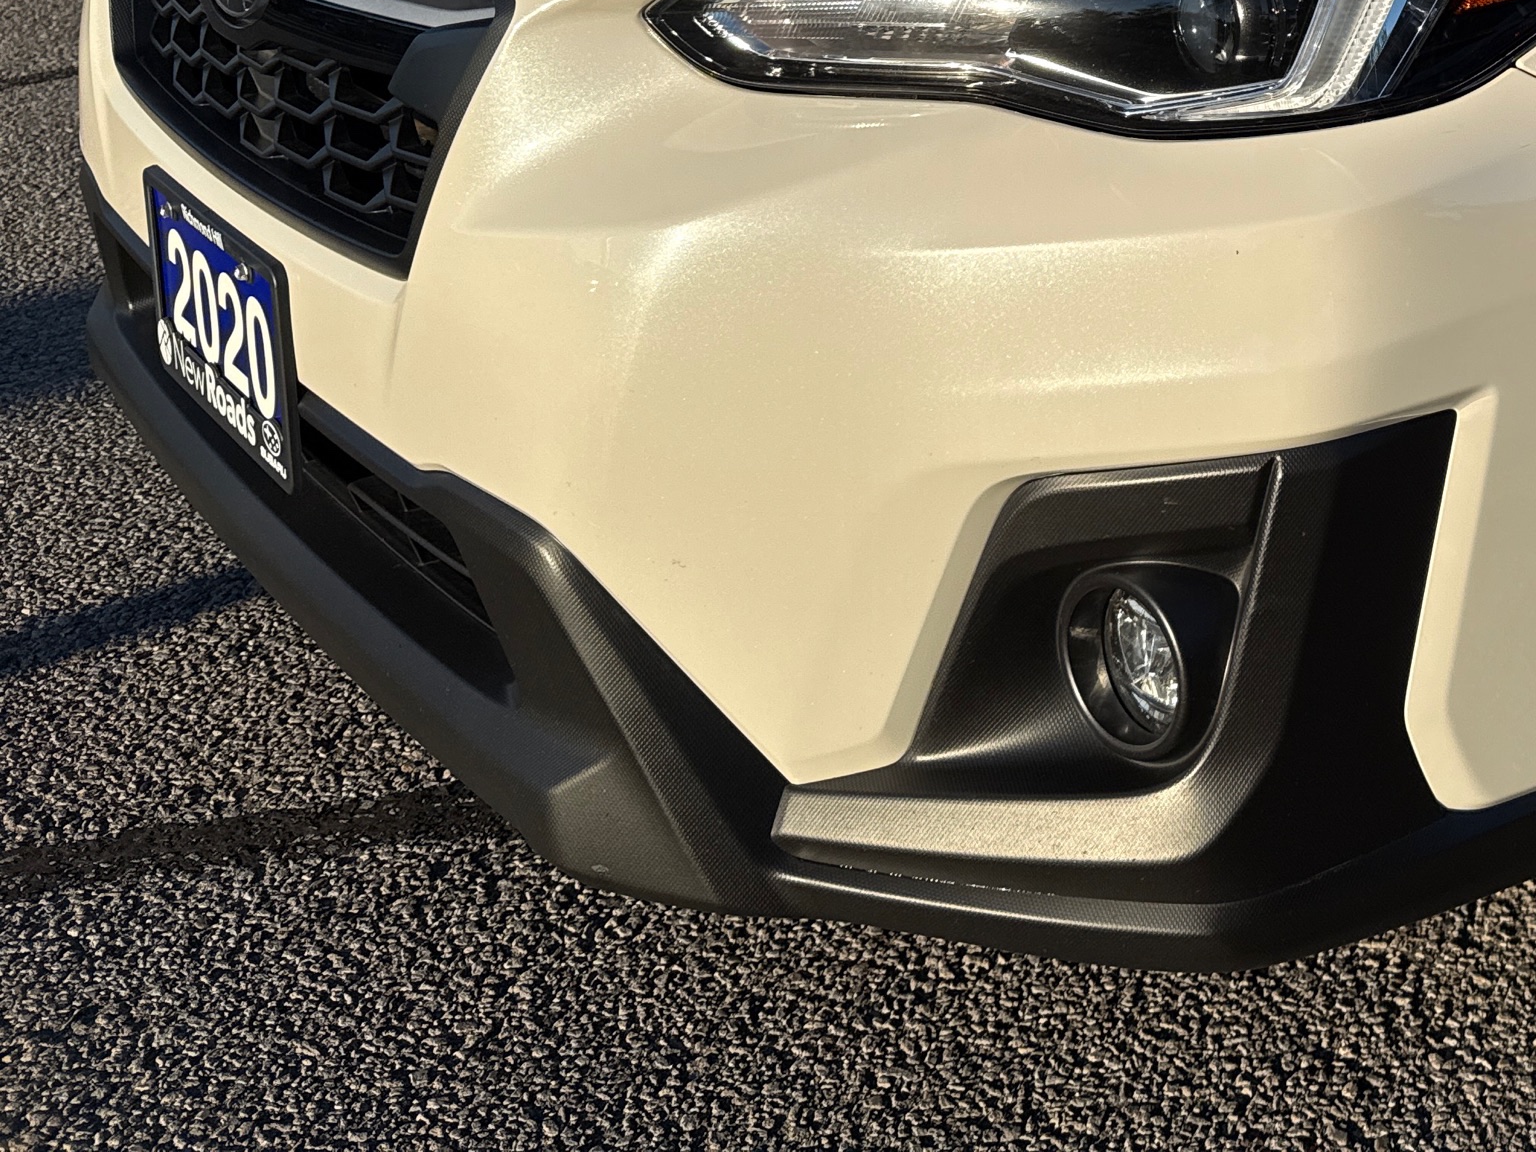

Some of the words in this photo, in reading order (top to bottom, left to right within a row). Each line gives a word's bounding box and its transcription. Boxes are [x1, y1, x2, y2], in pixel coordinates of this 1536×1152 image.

[180, 203, 214, 243] Richmond
[167, 227, 276, 420] 2020
[172, 332, 257, 447] NewRoads
[260, 445, 288, 480] SUBARU
